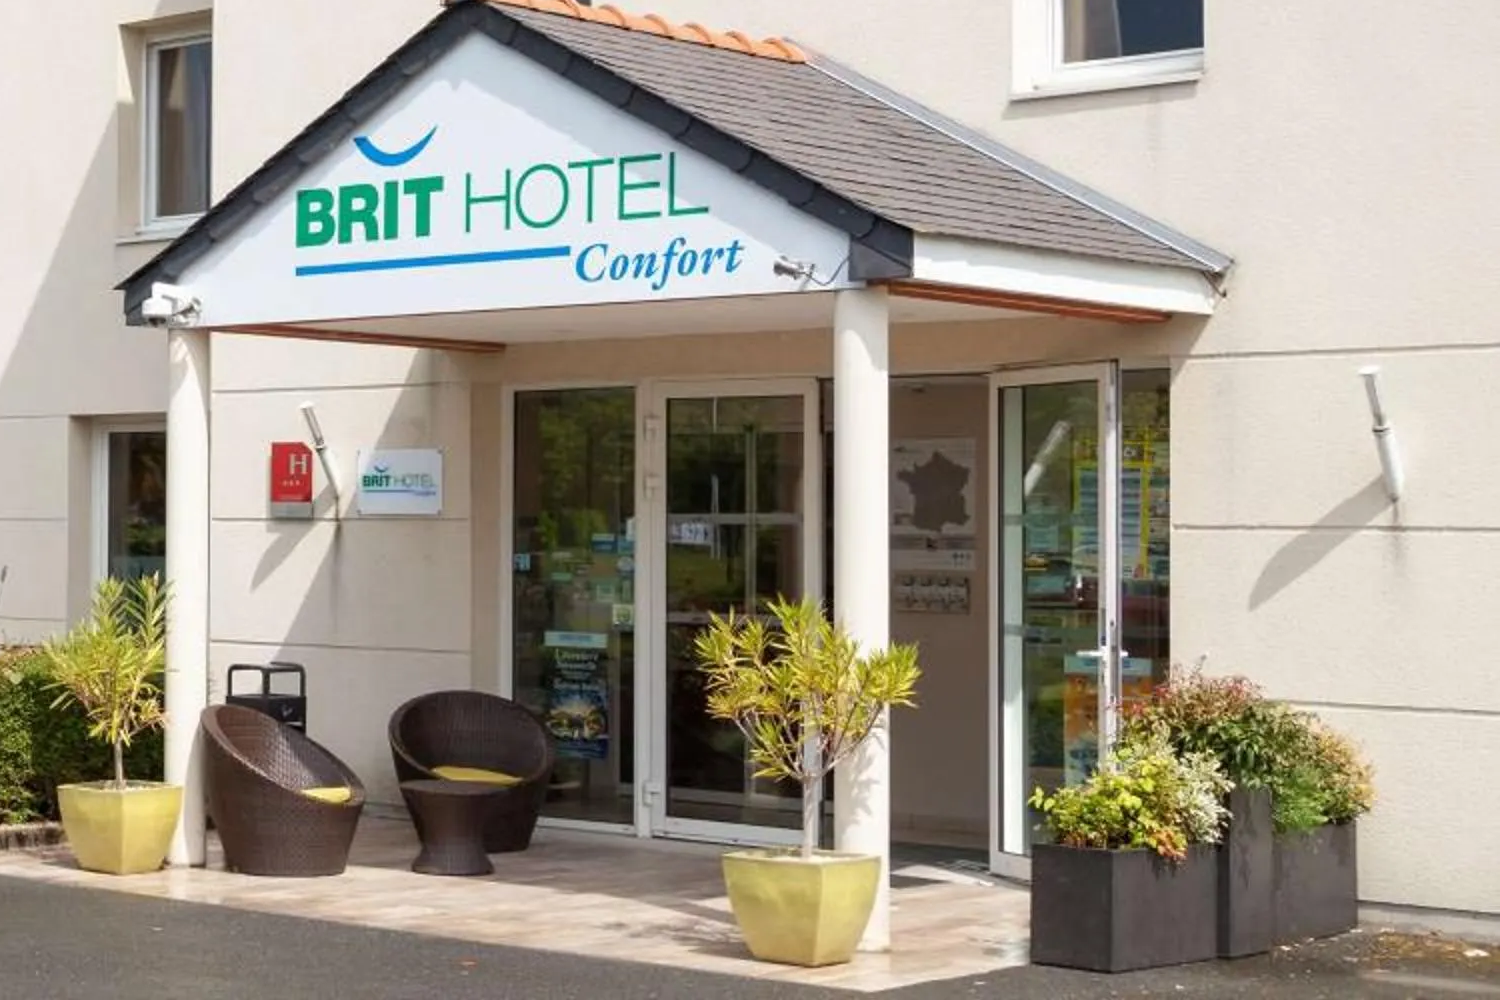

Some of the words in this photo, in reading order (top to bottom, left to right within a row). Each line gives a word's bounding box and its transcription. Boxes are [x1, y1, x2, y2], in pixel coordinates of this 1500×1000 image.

[295, 176, 443, 248] BRIT
[463, 152, 709, 234] HOTEL
[574, 237, 745, 290] Confort
[289, 454, 308, 475] H
[362, 475, 391, 487] BRIT
[393, 473, 437, 488] HOTEL
